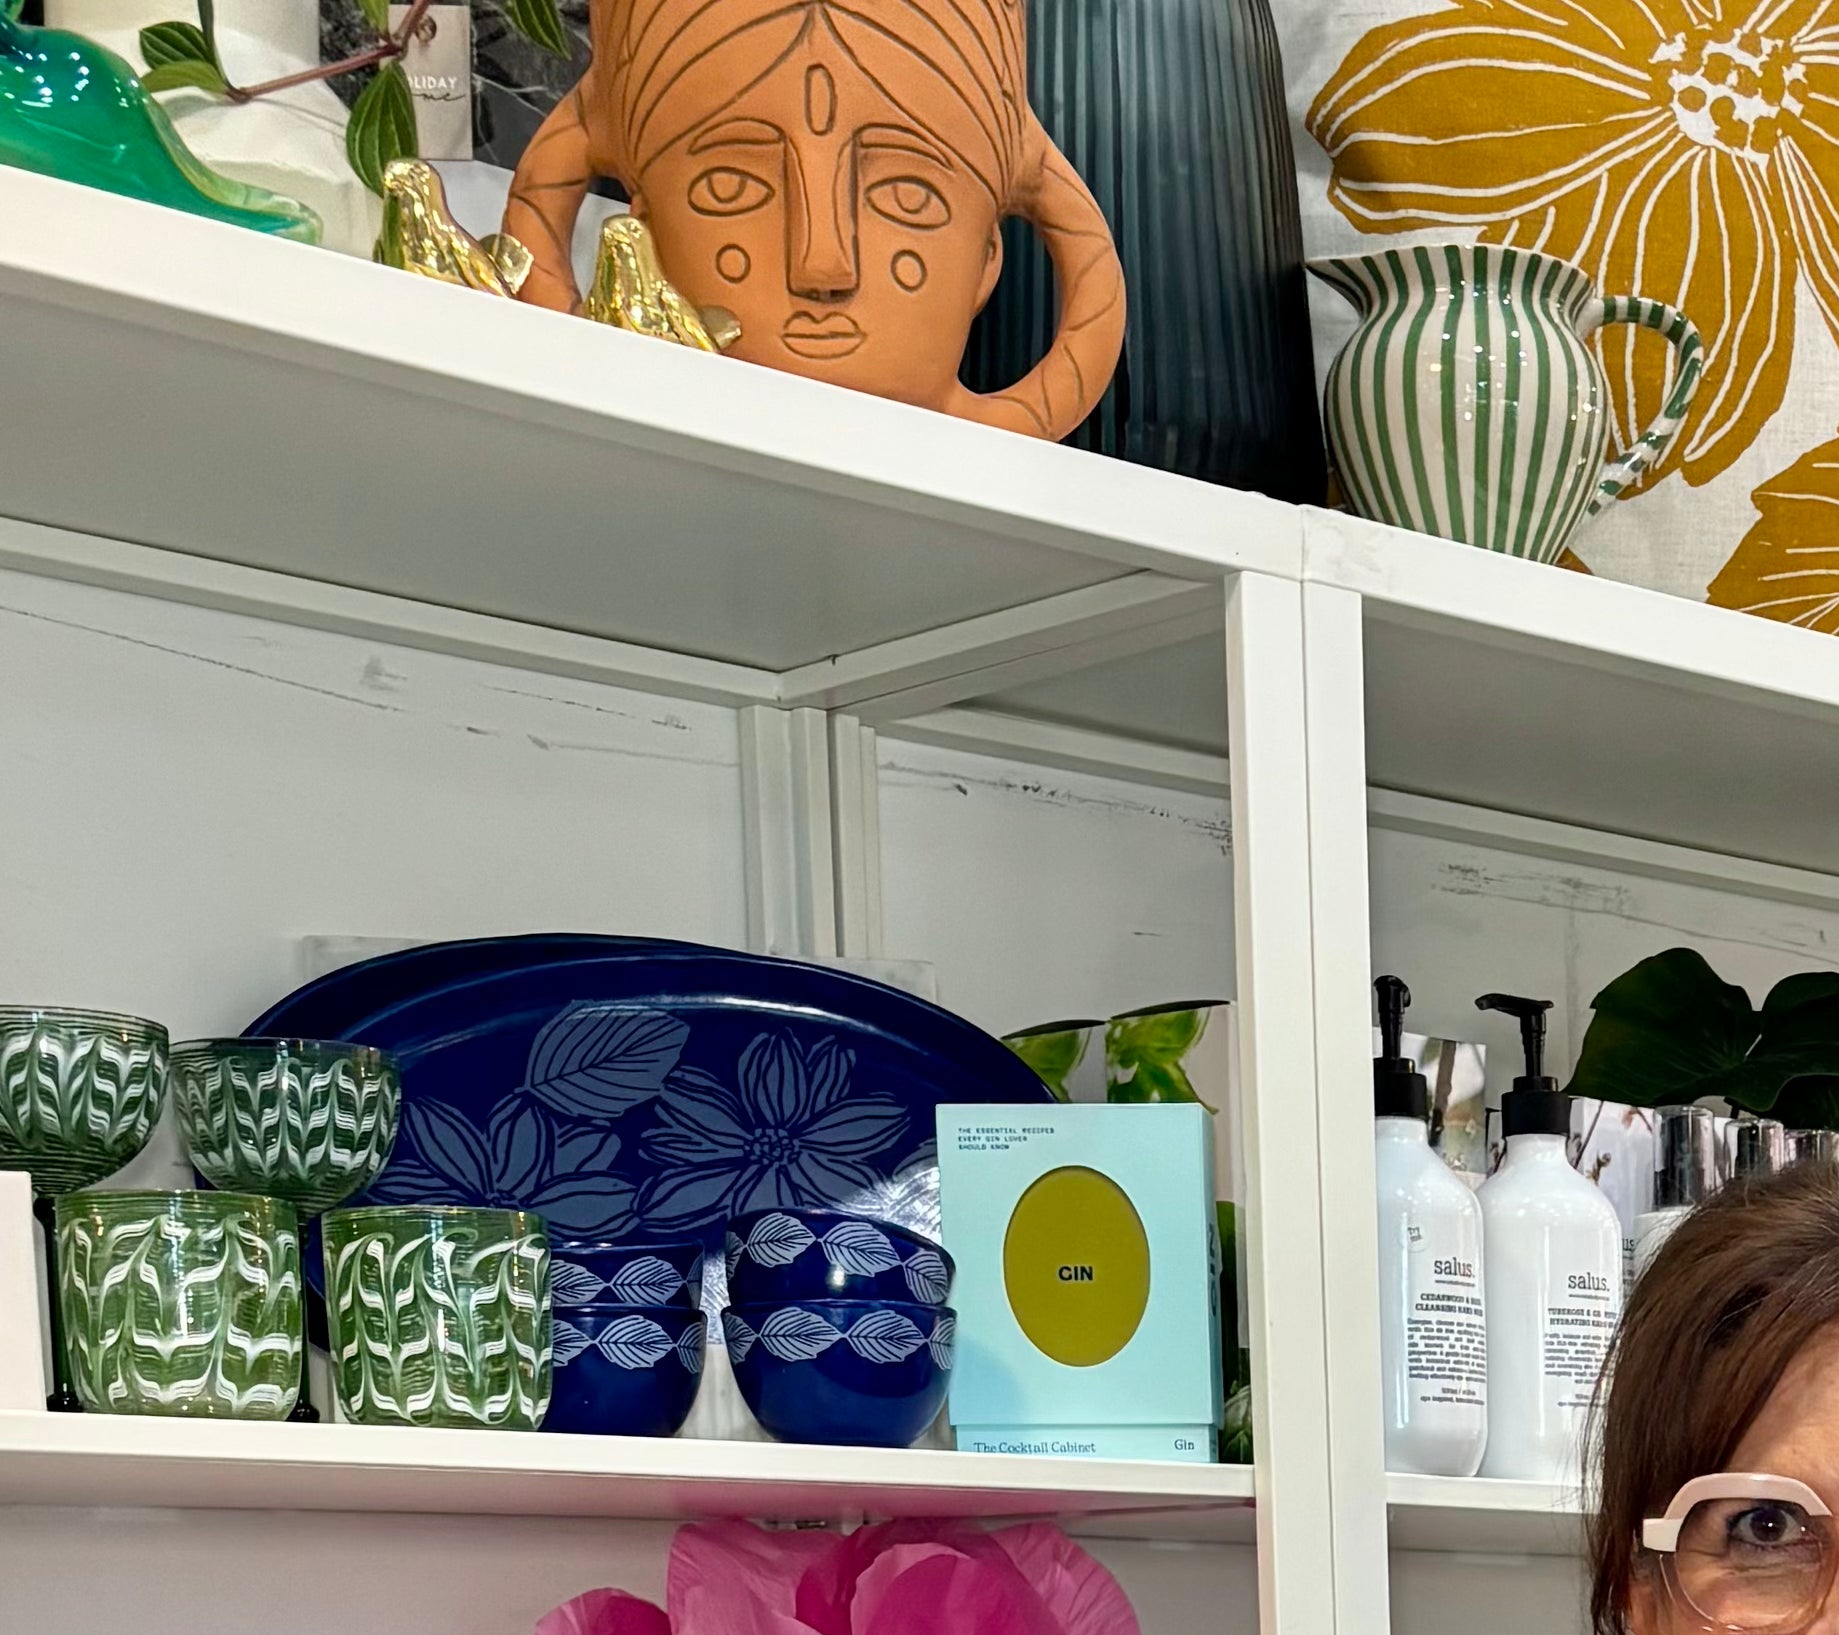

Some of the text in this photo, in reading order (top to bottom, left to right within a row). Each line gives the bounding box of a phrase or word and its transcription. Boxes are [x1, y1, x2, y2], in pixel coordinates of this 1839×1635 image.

[1057, 1265, 1094, 1282] GIN
[1434, 1256, 1475, 1278] salus.
[1568, 1271, 1610, 1292] salus.
[974, 1439, 1195, 1454] The Cocktail Cabinet Gin
